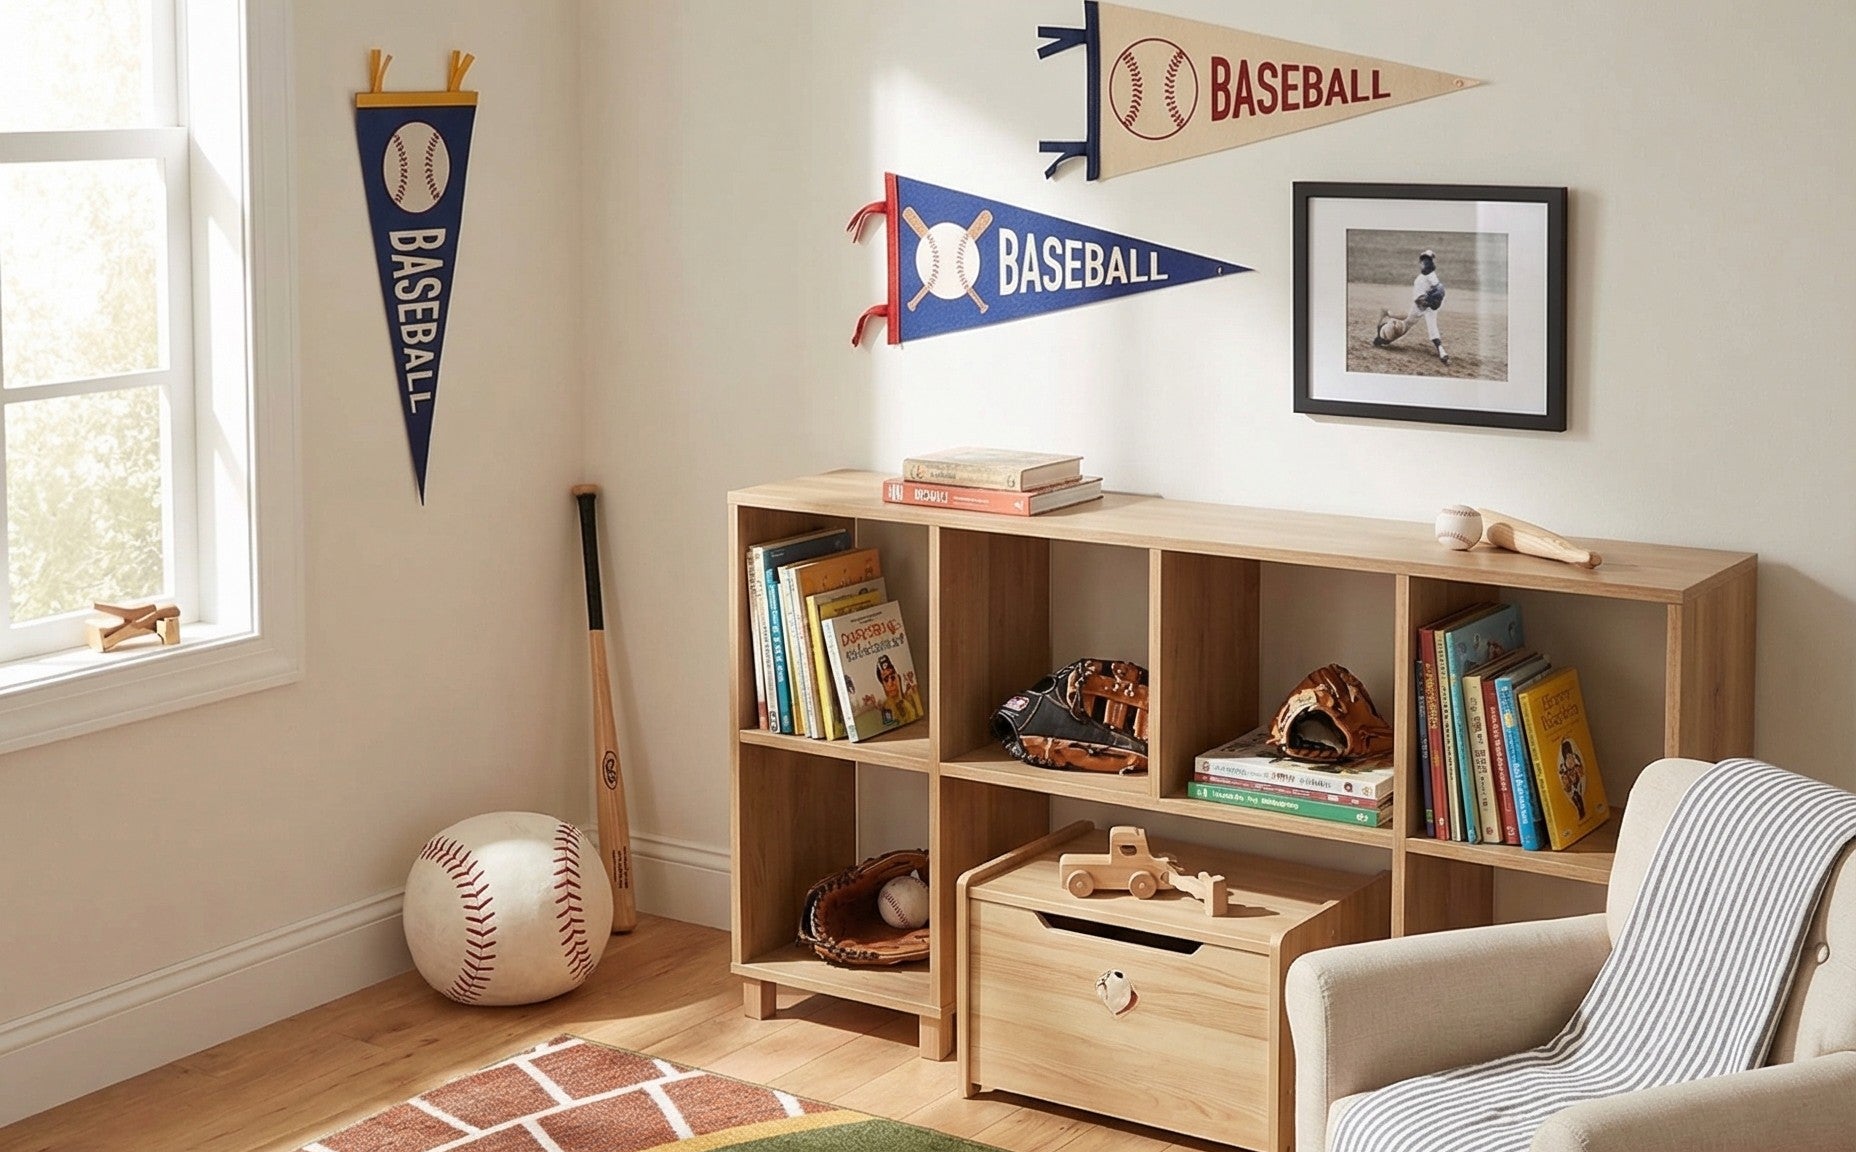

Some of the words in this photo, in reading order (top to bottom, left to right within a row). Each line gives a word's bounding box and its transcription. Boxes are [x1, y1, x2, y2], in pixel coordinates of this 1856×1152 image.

[1210, 56, 1391, 121] BASEBALL
[998, 227, 1168, 296] BASEBALL
[388, 227, 446, 414] BASEBALL
